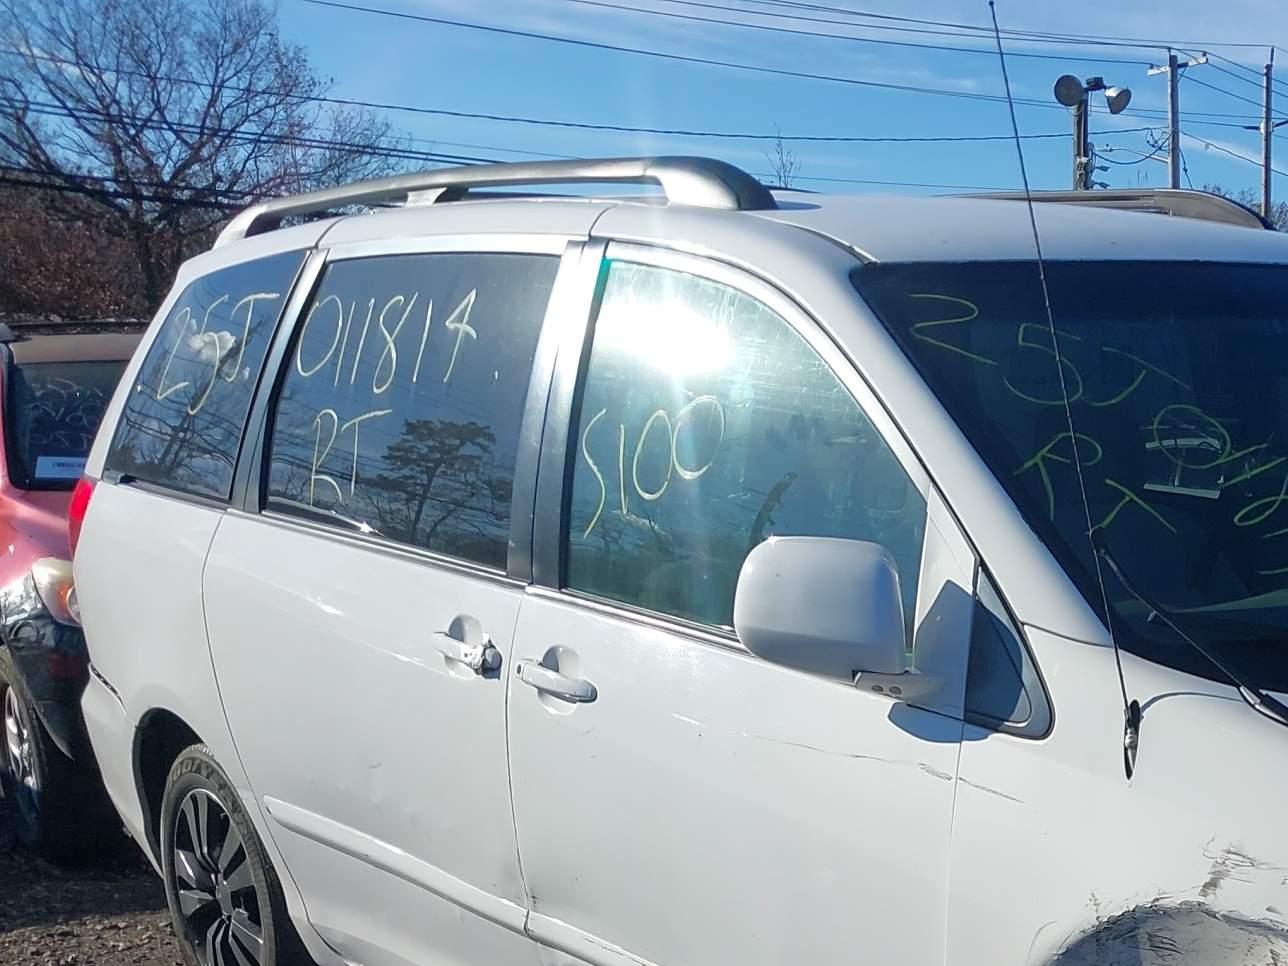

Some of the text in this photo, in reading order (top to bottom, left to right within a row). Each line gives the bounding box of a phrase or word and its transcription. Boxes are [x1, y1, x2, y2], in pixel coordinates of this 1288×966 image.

[157, 293, 279, 415] 25J
[296, 288, 477, 393] 011814
[309, 408, 393, 506] RT
[582, 395, 726, 539] S100
